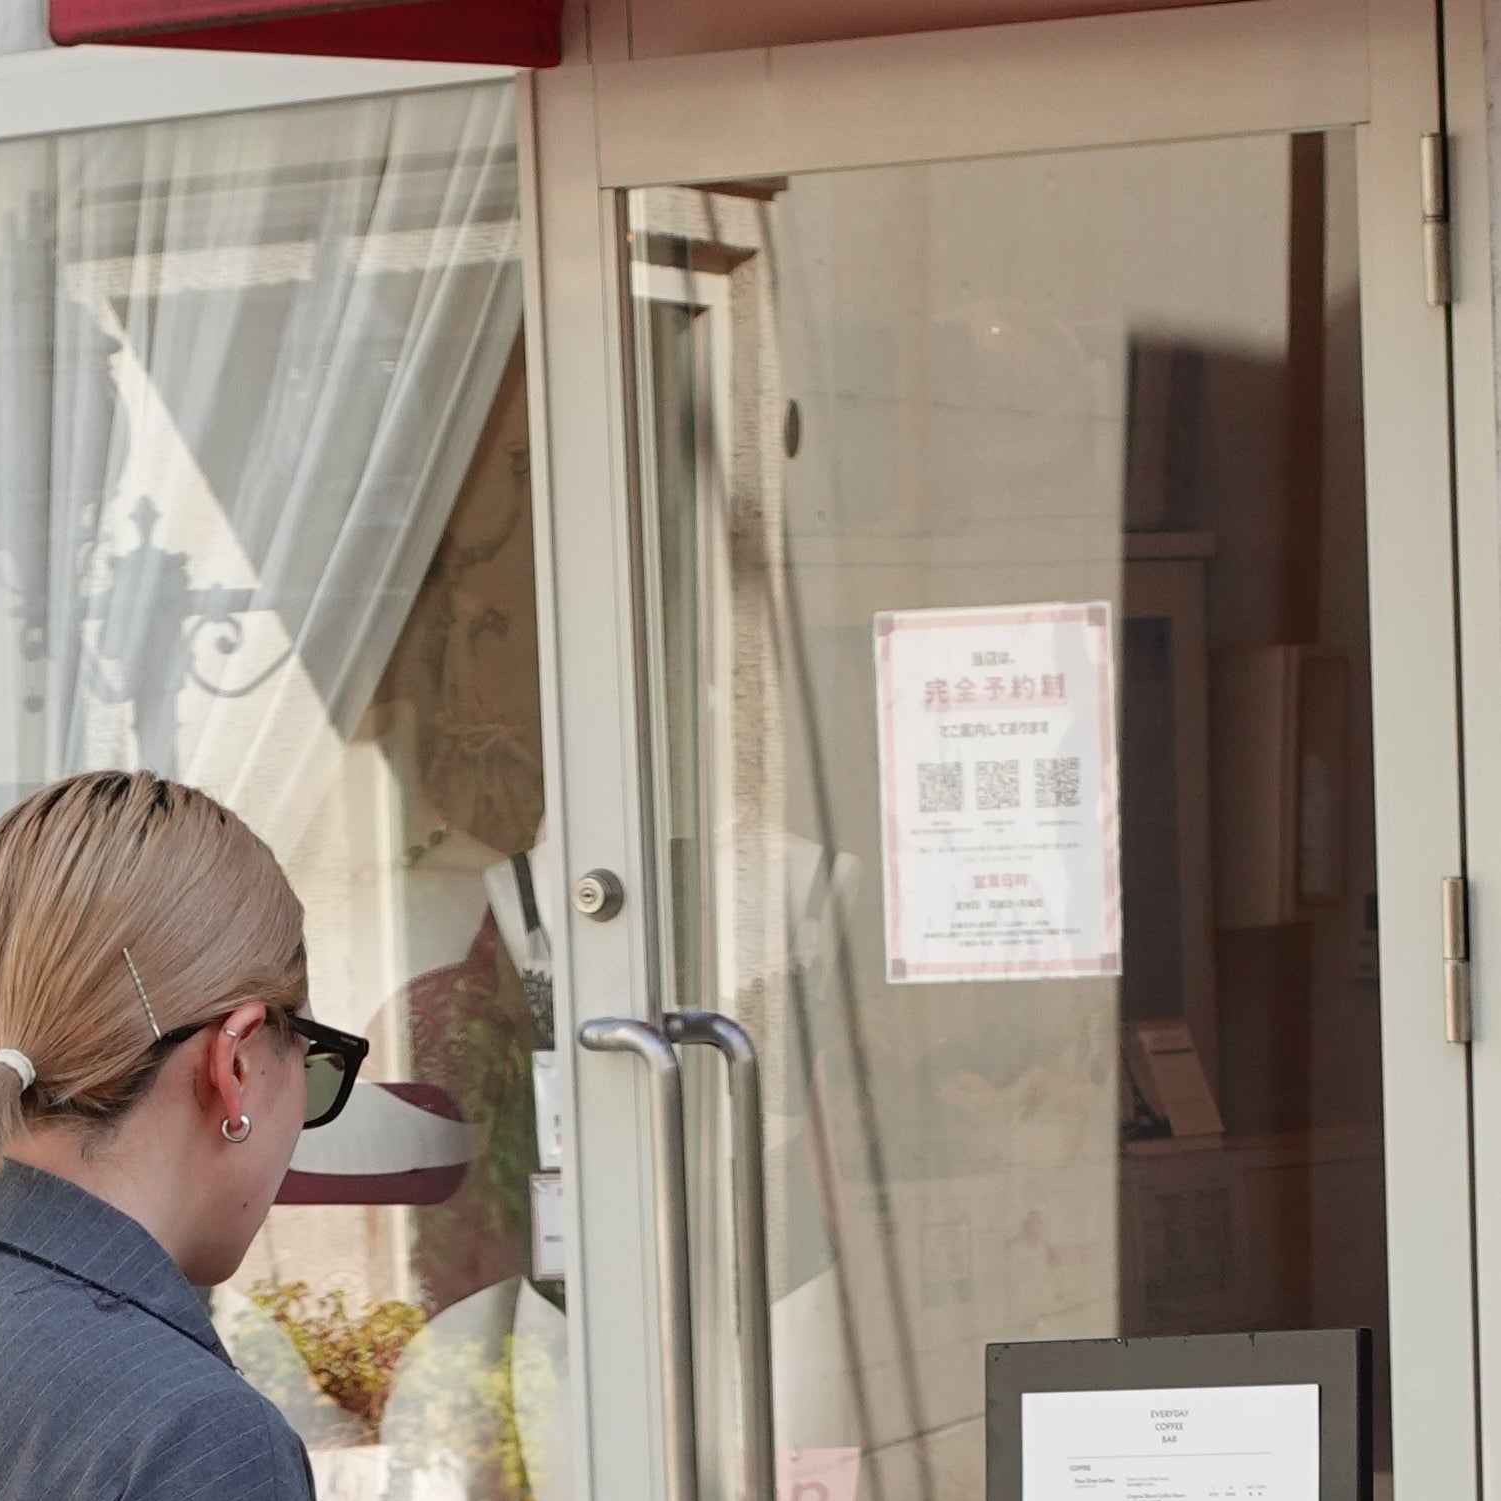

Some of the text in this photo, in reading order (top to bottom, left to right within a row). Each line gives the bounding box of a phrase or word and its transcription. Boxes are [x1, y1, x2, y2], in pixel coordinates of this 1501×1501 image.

[1150, 1409, 1189, 1419] EVERYDAY
[1155, 1422, 1184, 1431] COFFEE
[1161, 1435, 1178, 1444] BAR
